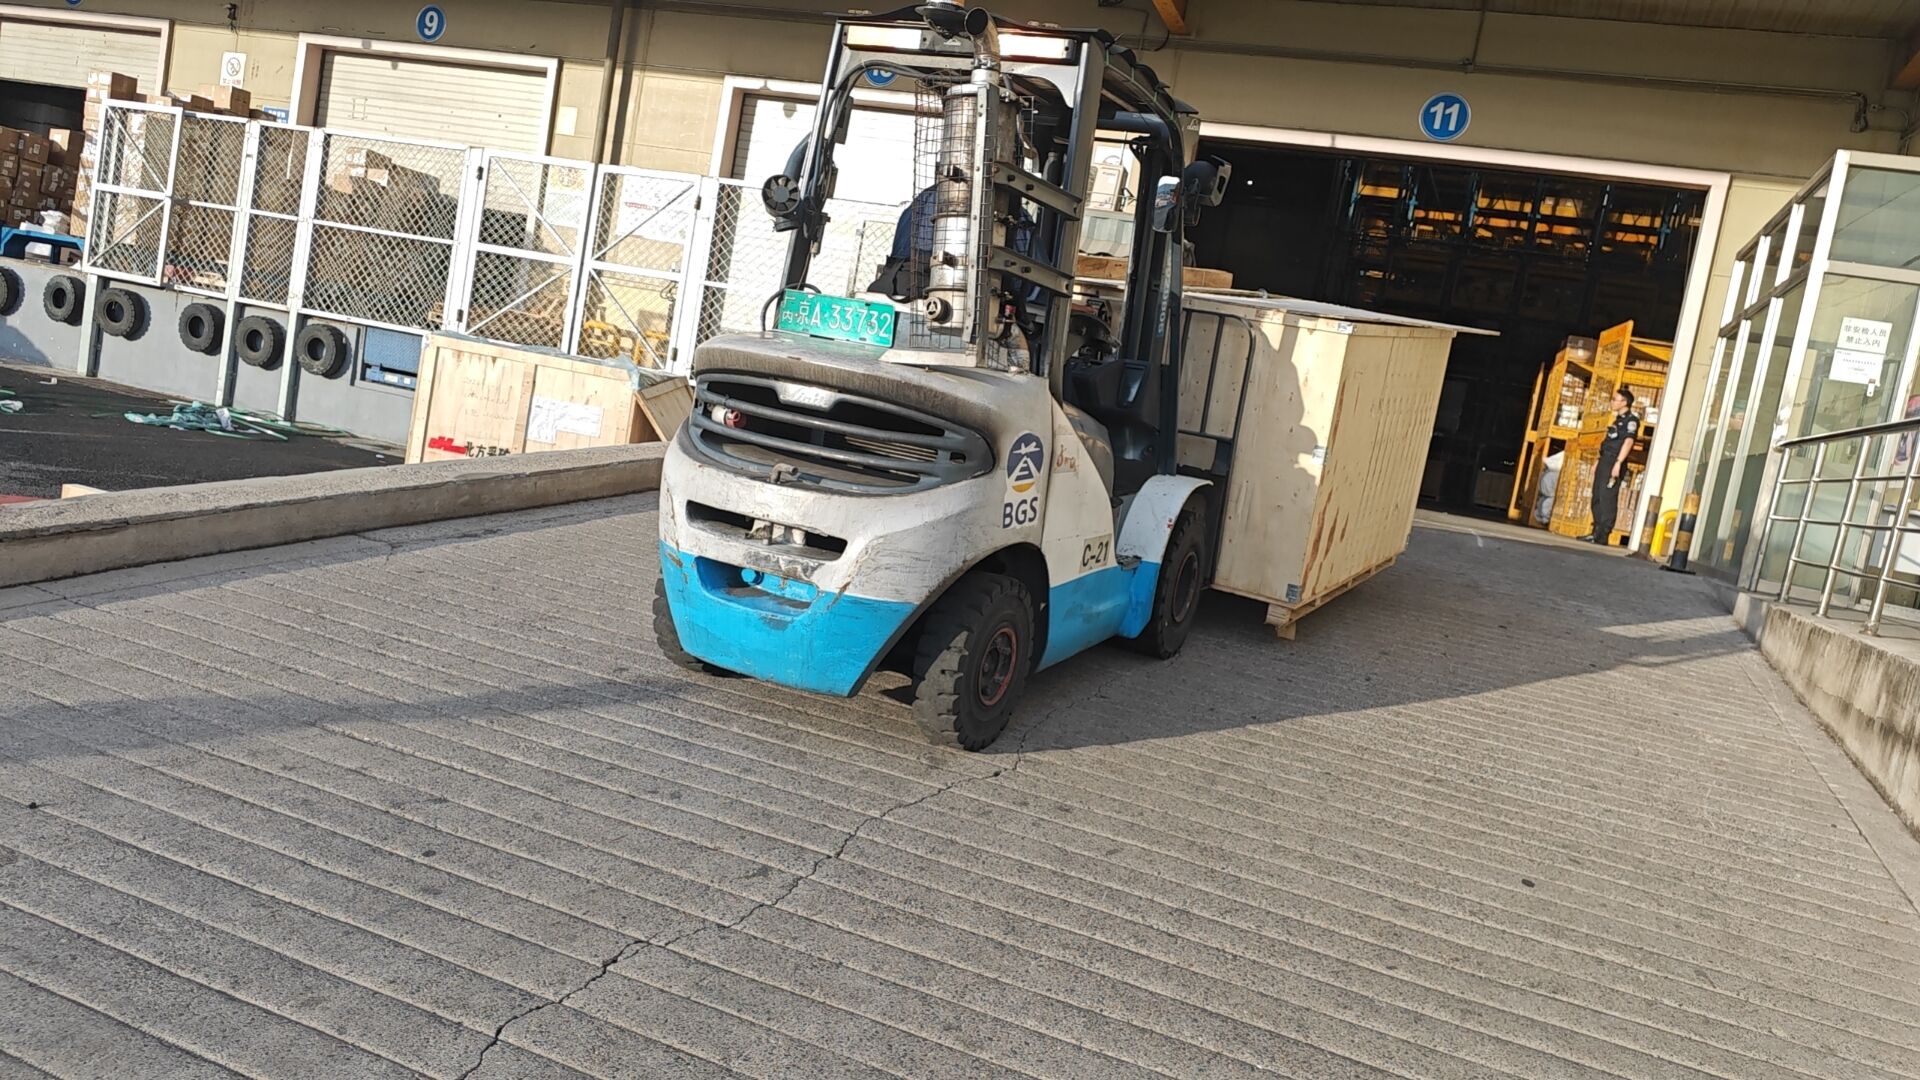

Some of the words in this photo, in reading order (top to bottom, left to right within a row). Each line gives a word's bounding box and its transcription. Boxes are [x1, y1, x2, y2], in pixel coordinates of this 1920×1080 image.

[424, 11, 438, 36] 9
[1429, 101, 1460, 131] 11
[1844, 324, 1887, 338] 非安检人员
[1845, 335, 1881, 348] 禁止入内
[1002, 496, 1039, 529] BGS
[1082, 540, 1110, 567] C-21
